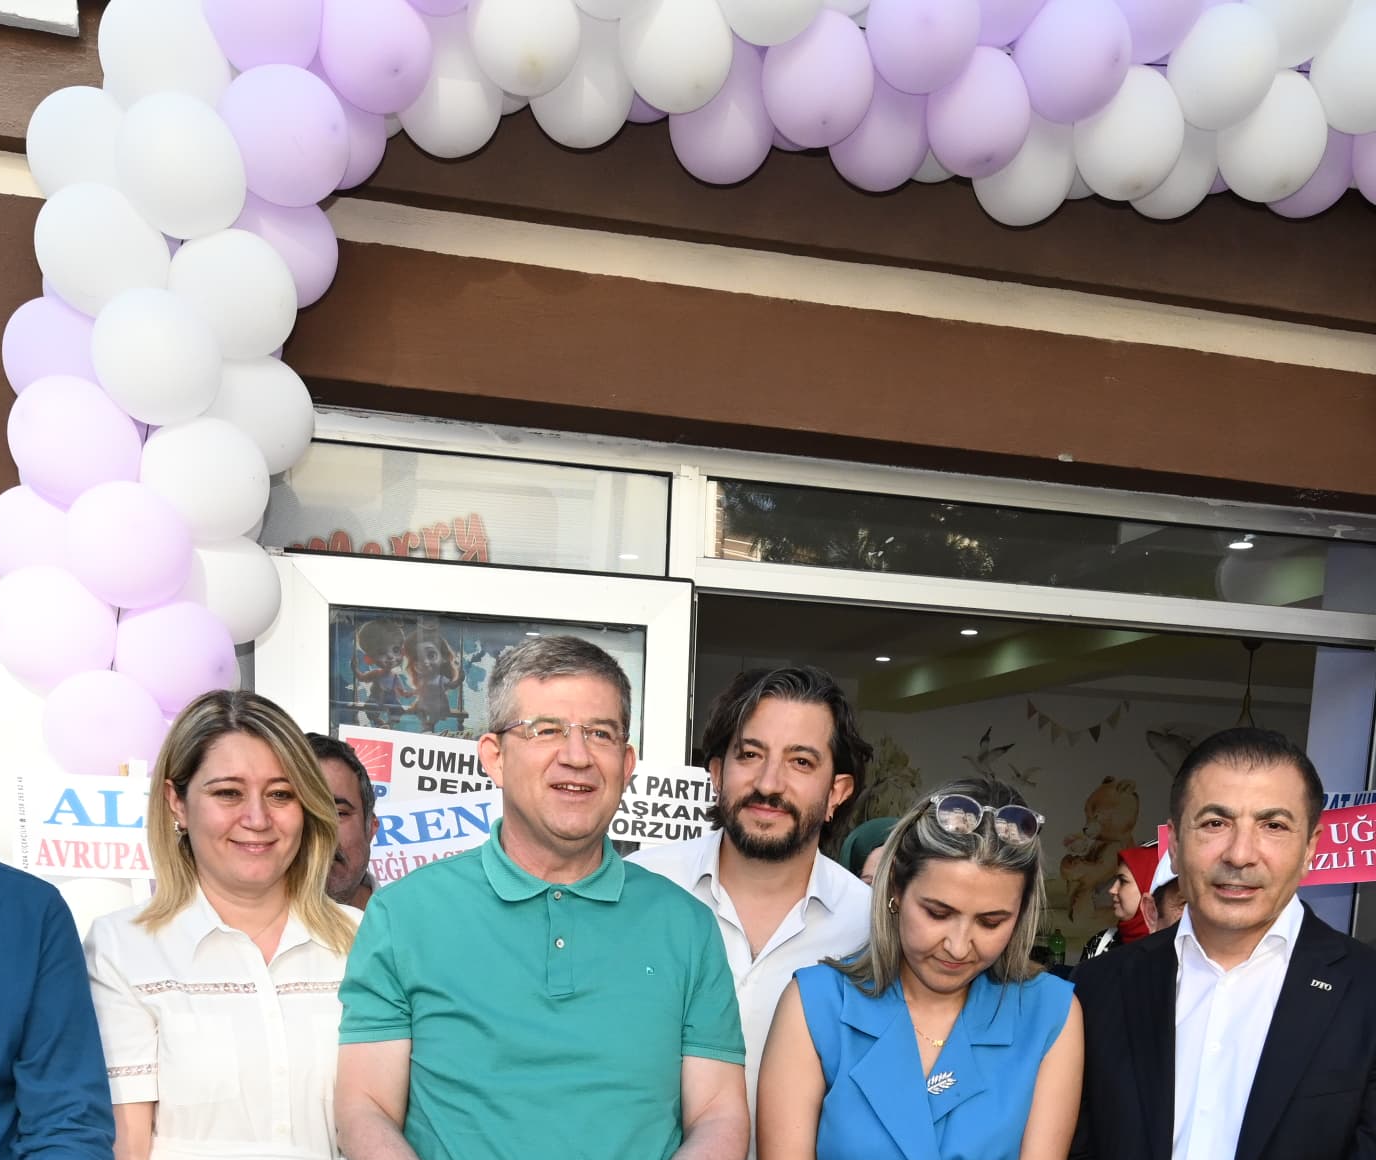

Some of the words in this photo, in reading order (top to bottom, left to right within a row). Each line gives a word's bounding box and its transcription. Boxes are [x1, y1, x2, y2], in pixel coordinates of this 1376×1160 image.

[646, 775, 718, 803] PARTİ
[43, 788, 149, 829] AL
[35, 838, 150, 871] AVRUPA
